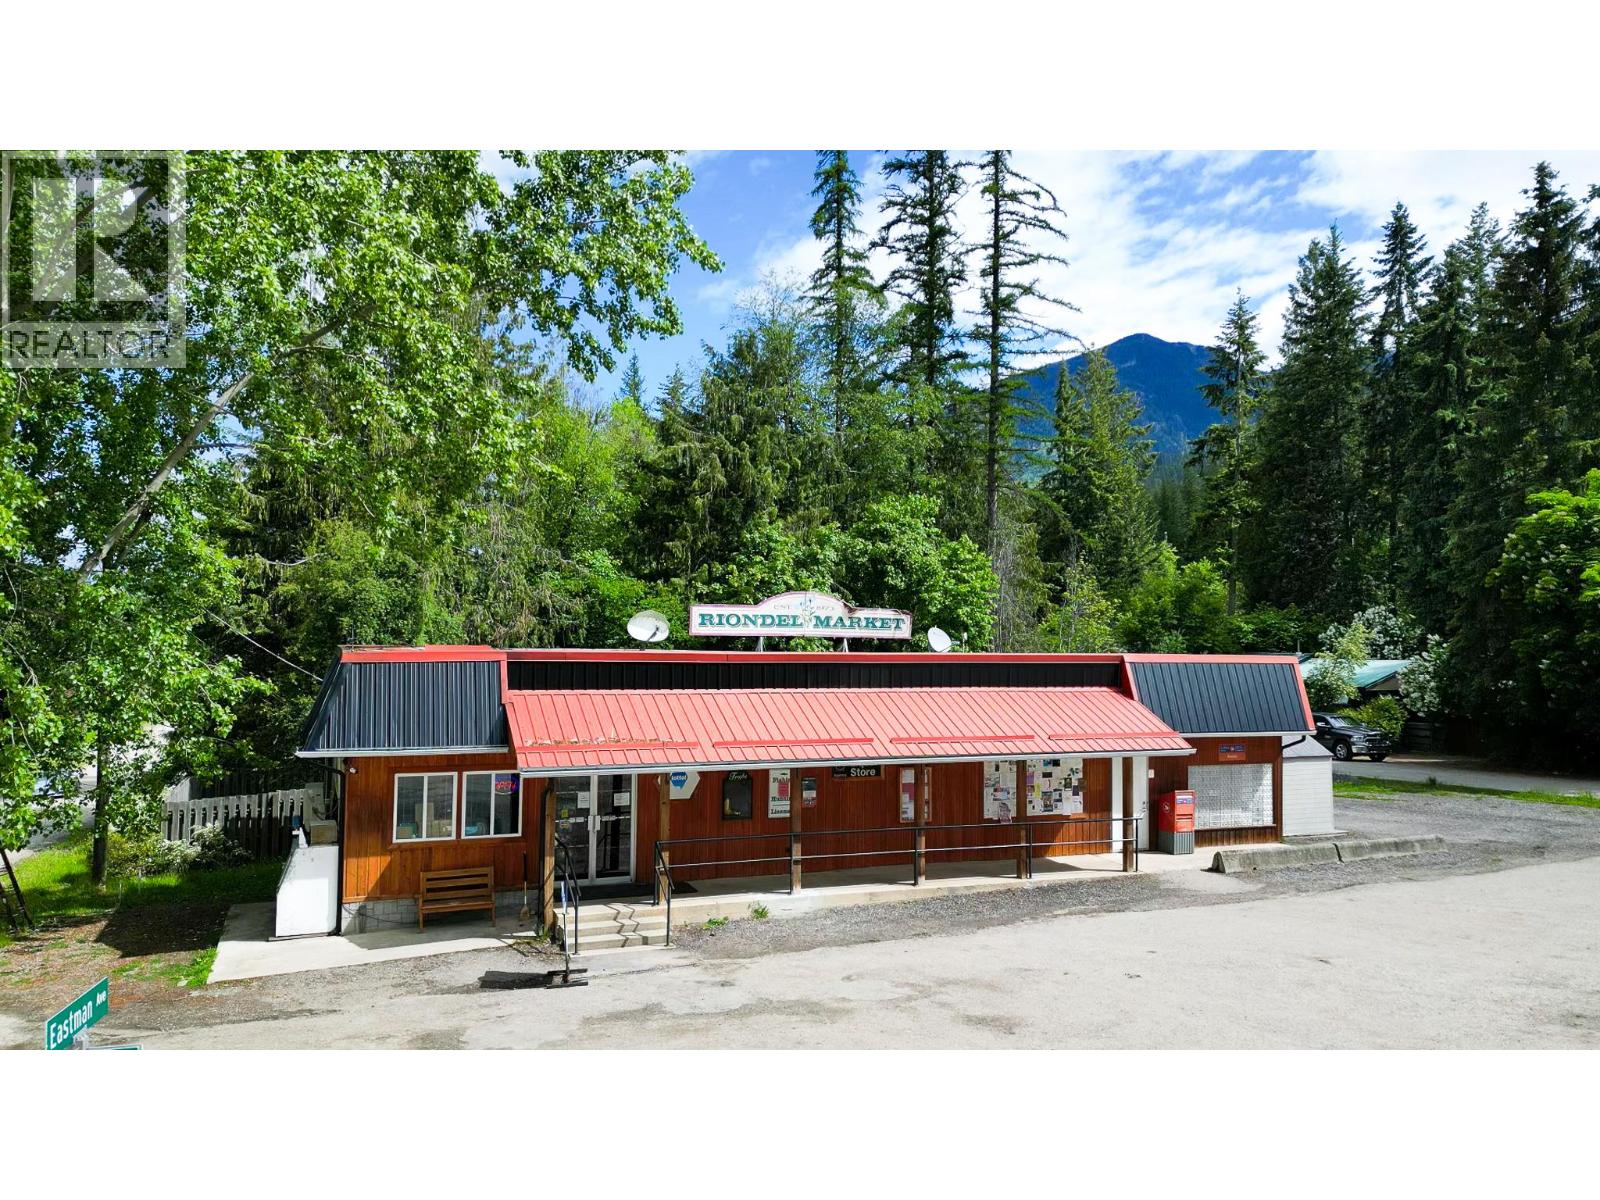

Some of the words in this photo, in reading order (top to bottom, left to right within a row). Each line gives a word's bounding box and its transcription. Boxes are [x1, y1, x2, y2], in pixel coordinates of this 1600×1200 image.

[699, 613, 803, 628] RIONDEL
[813, 615, 905, 631] MARKET
[850, 767, 876, 777] Store
[50, 1000, 93, 1049] Eastman
[96, 991, 107, 1007] Ave
